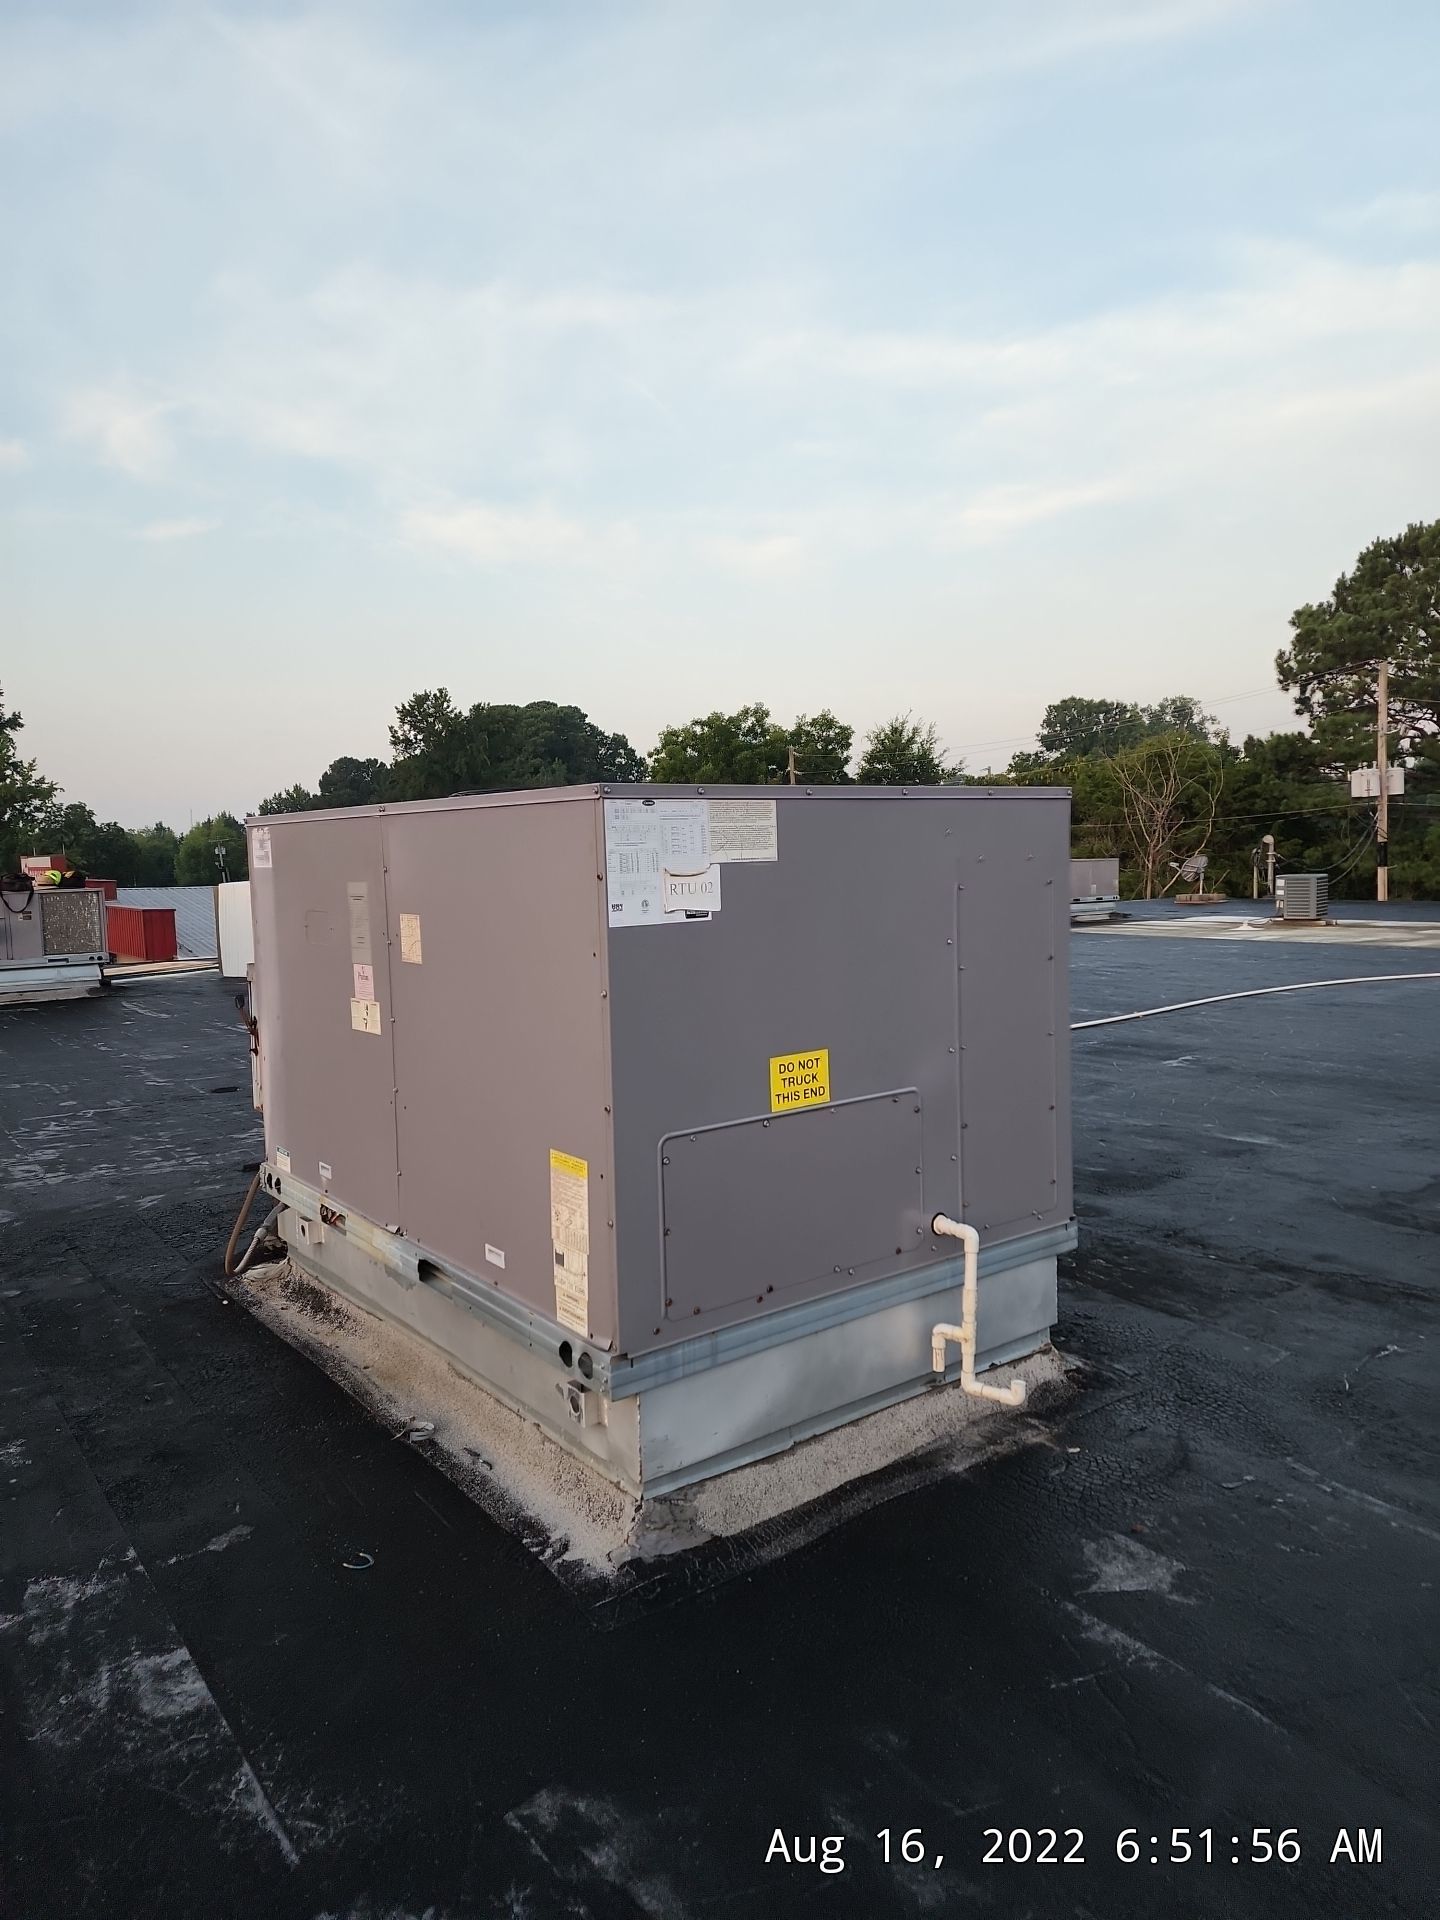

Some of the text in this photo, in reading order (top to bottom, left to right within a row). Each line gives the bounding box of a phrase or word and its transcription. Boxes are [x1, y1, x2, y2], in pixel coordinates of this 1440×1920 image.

[669, 881, 713, 896] RTU 02
[778, 1057, 821, 1074] DO NOT
[780, 1072, 819, 1088] TRUCK
[775, 1086, 826, 1104] THIS END
